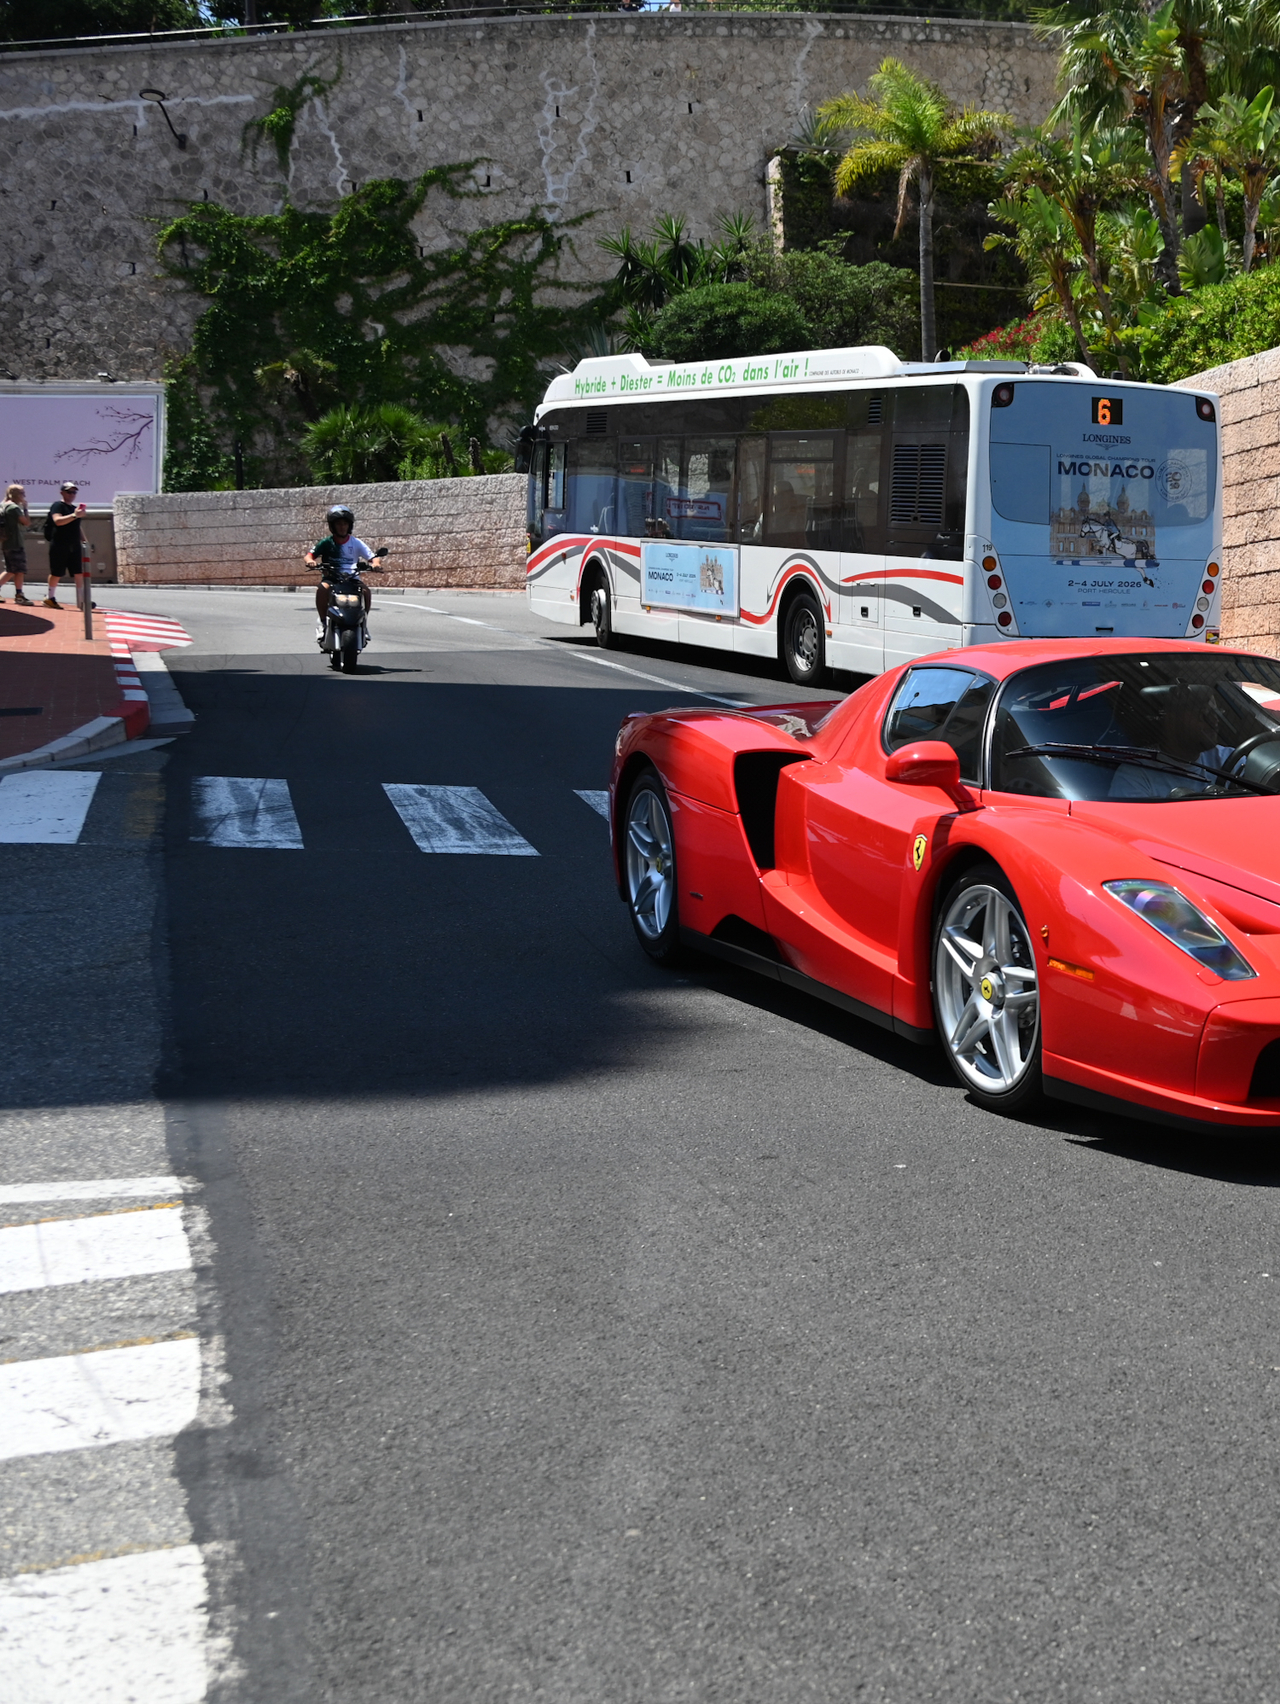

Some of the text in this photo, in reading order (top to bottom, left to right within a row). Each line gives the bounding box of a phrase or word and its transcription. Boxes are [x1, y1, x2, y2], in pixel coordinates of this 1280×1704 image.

[575, 376, 607, 399] Hybride
[620, 374, 653, 391] Diester
[667, 369, 696, 388] Moins
[701, 366, 713, 385] de
[743, 362, 769, 381] dans
[774, 358, 799, 378] l'air
[1097, 398, 1111, 425] 6
[1082, 433, 1131, 445] LONGINES
[1058, 460, 1155, 479] MONACO
[982, 544, 993, 553] 119
[648, 571, 673, 581] MONACO
[1118, 580, 1142, 588] 2026
